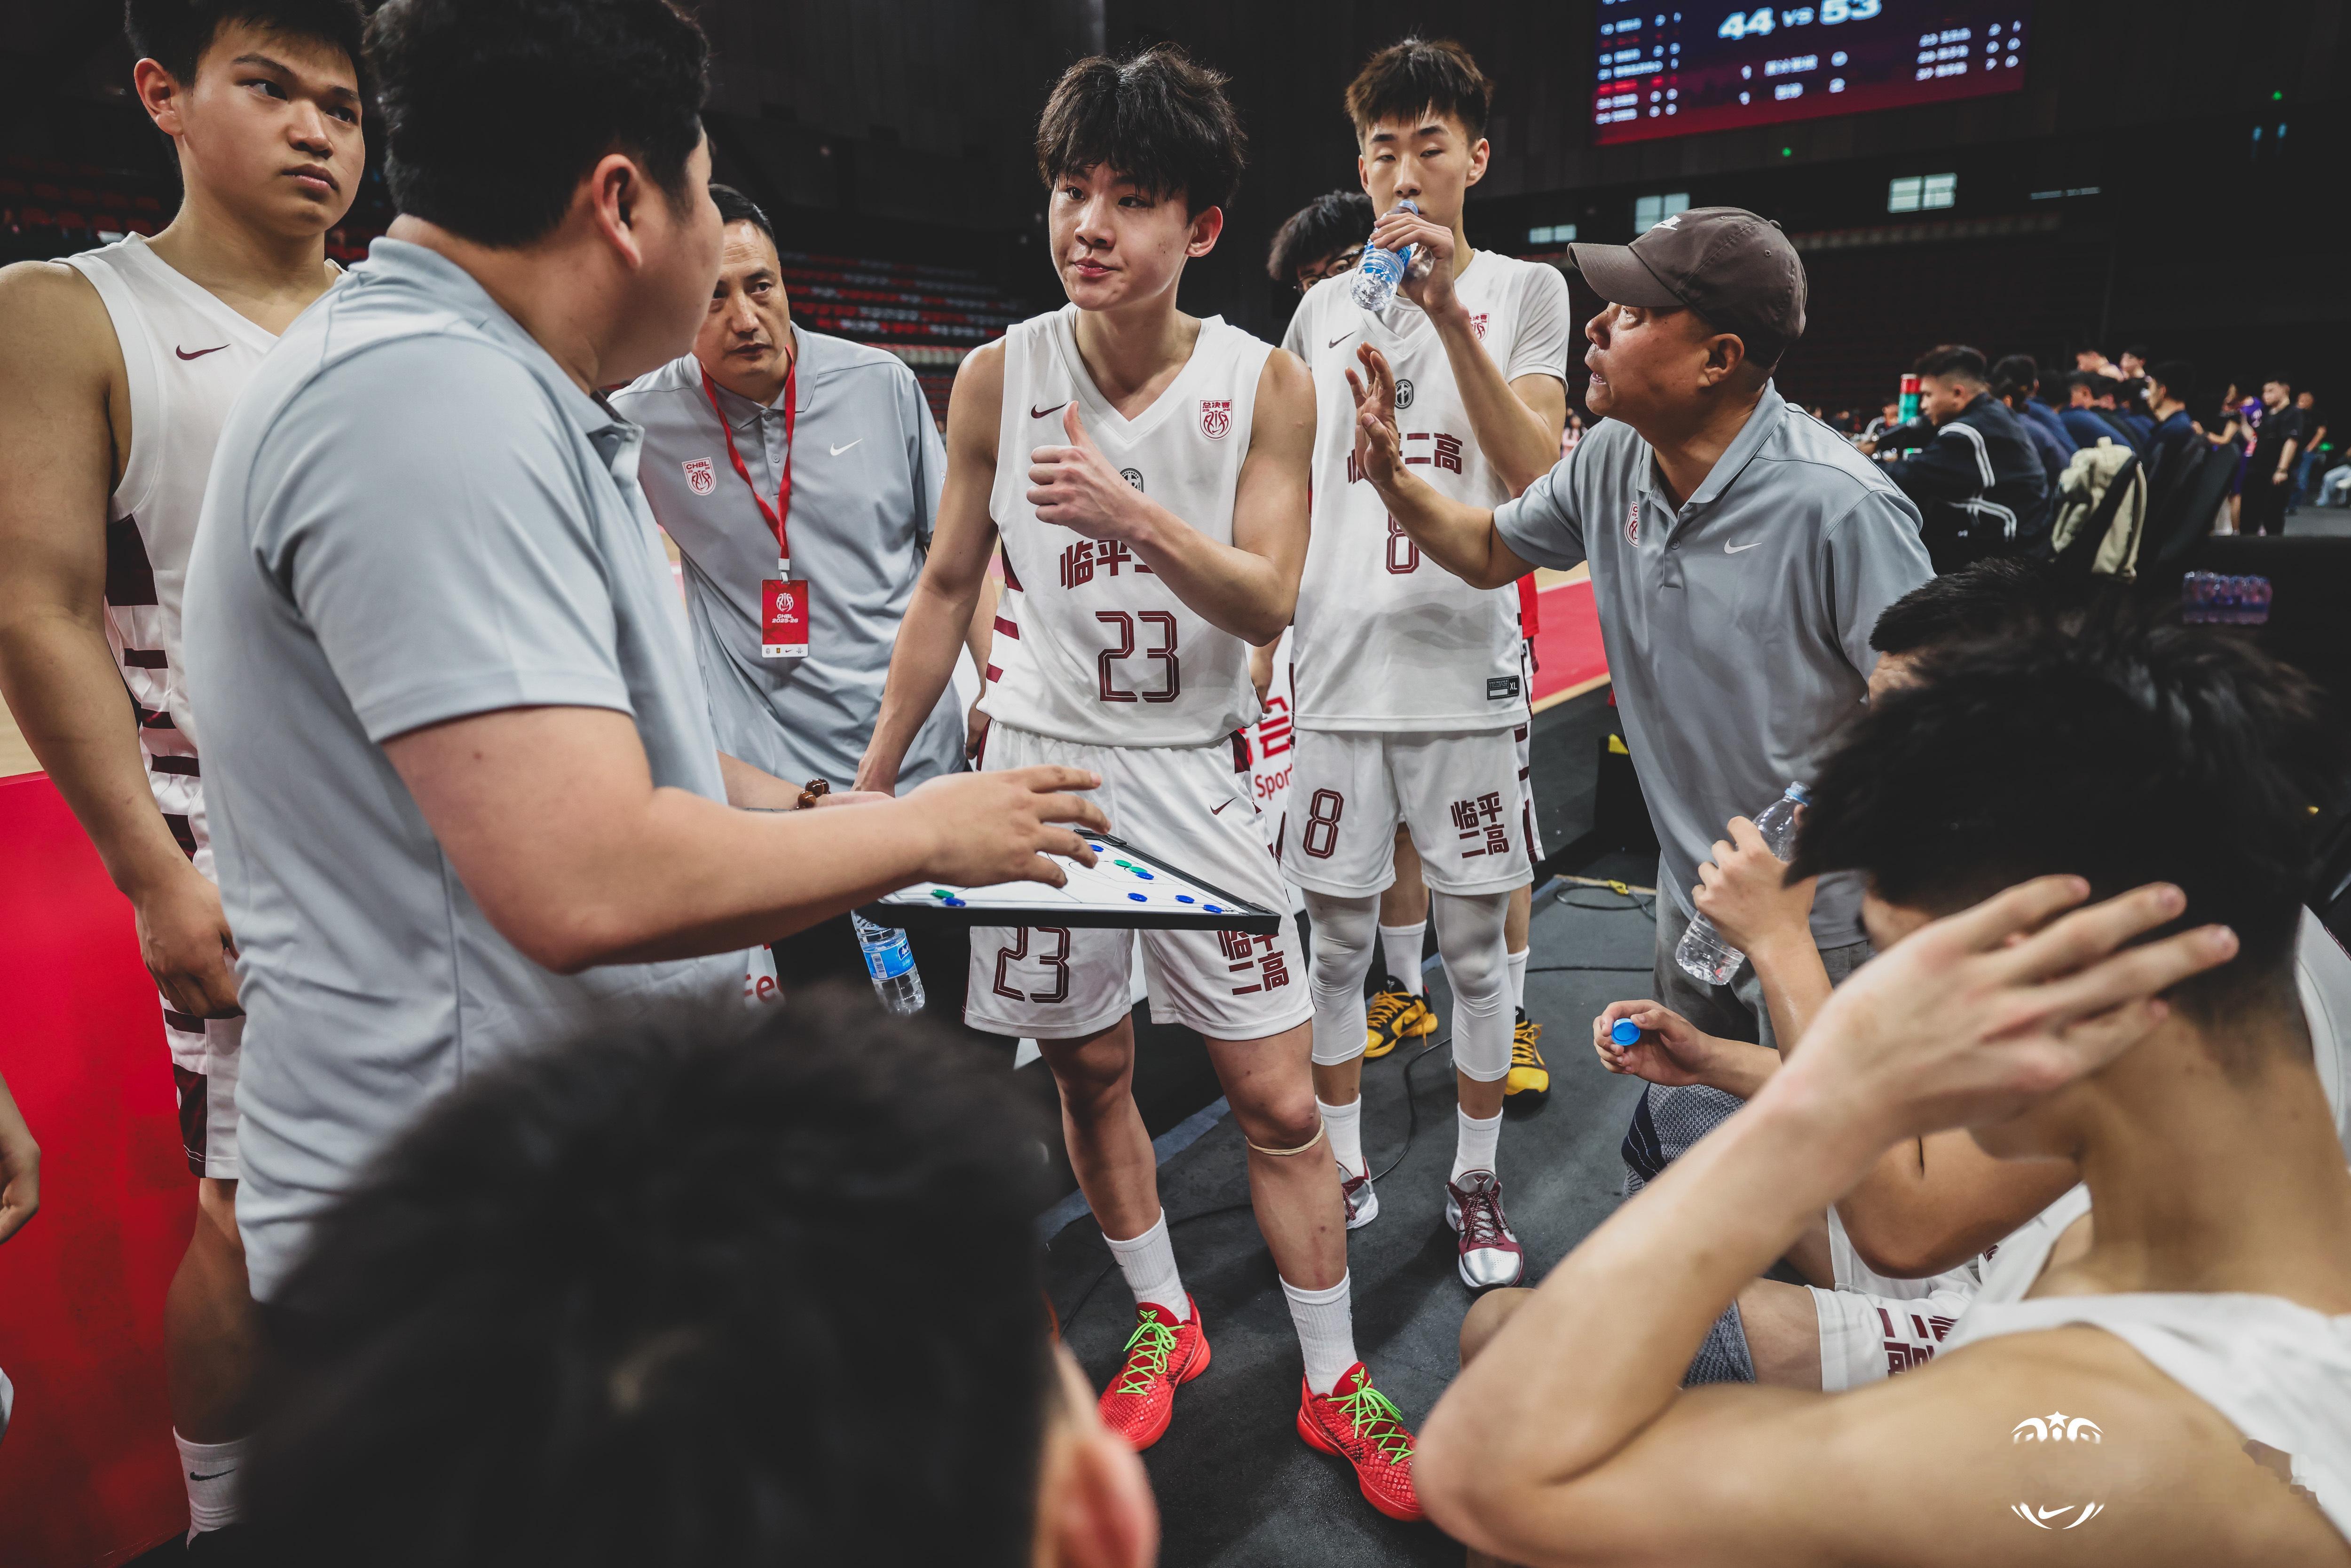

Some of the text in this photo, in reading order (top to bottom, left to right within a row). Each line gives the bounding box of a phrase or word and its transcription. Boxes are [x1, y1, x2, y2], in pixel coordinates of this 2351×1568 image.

[1718, 7, 1775, 40] 44
[1819, 0, 1882, 25] 53
[686, 461, 709, 470] CHBL
[1347, 433, 1463, 485] 二高
[1060, 540, 1155, 590] 临平
[1096, 611, 1180, 703] 23
[1510, 682, 1517, 691] XL
[1254, 763, 1293, 801] Spor
[1302, 788, 1345, 859] 8
[993, 926, 1071, 1004] 23
